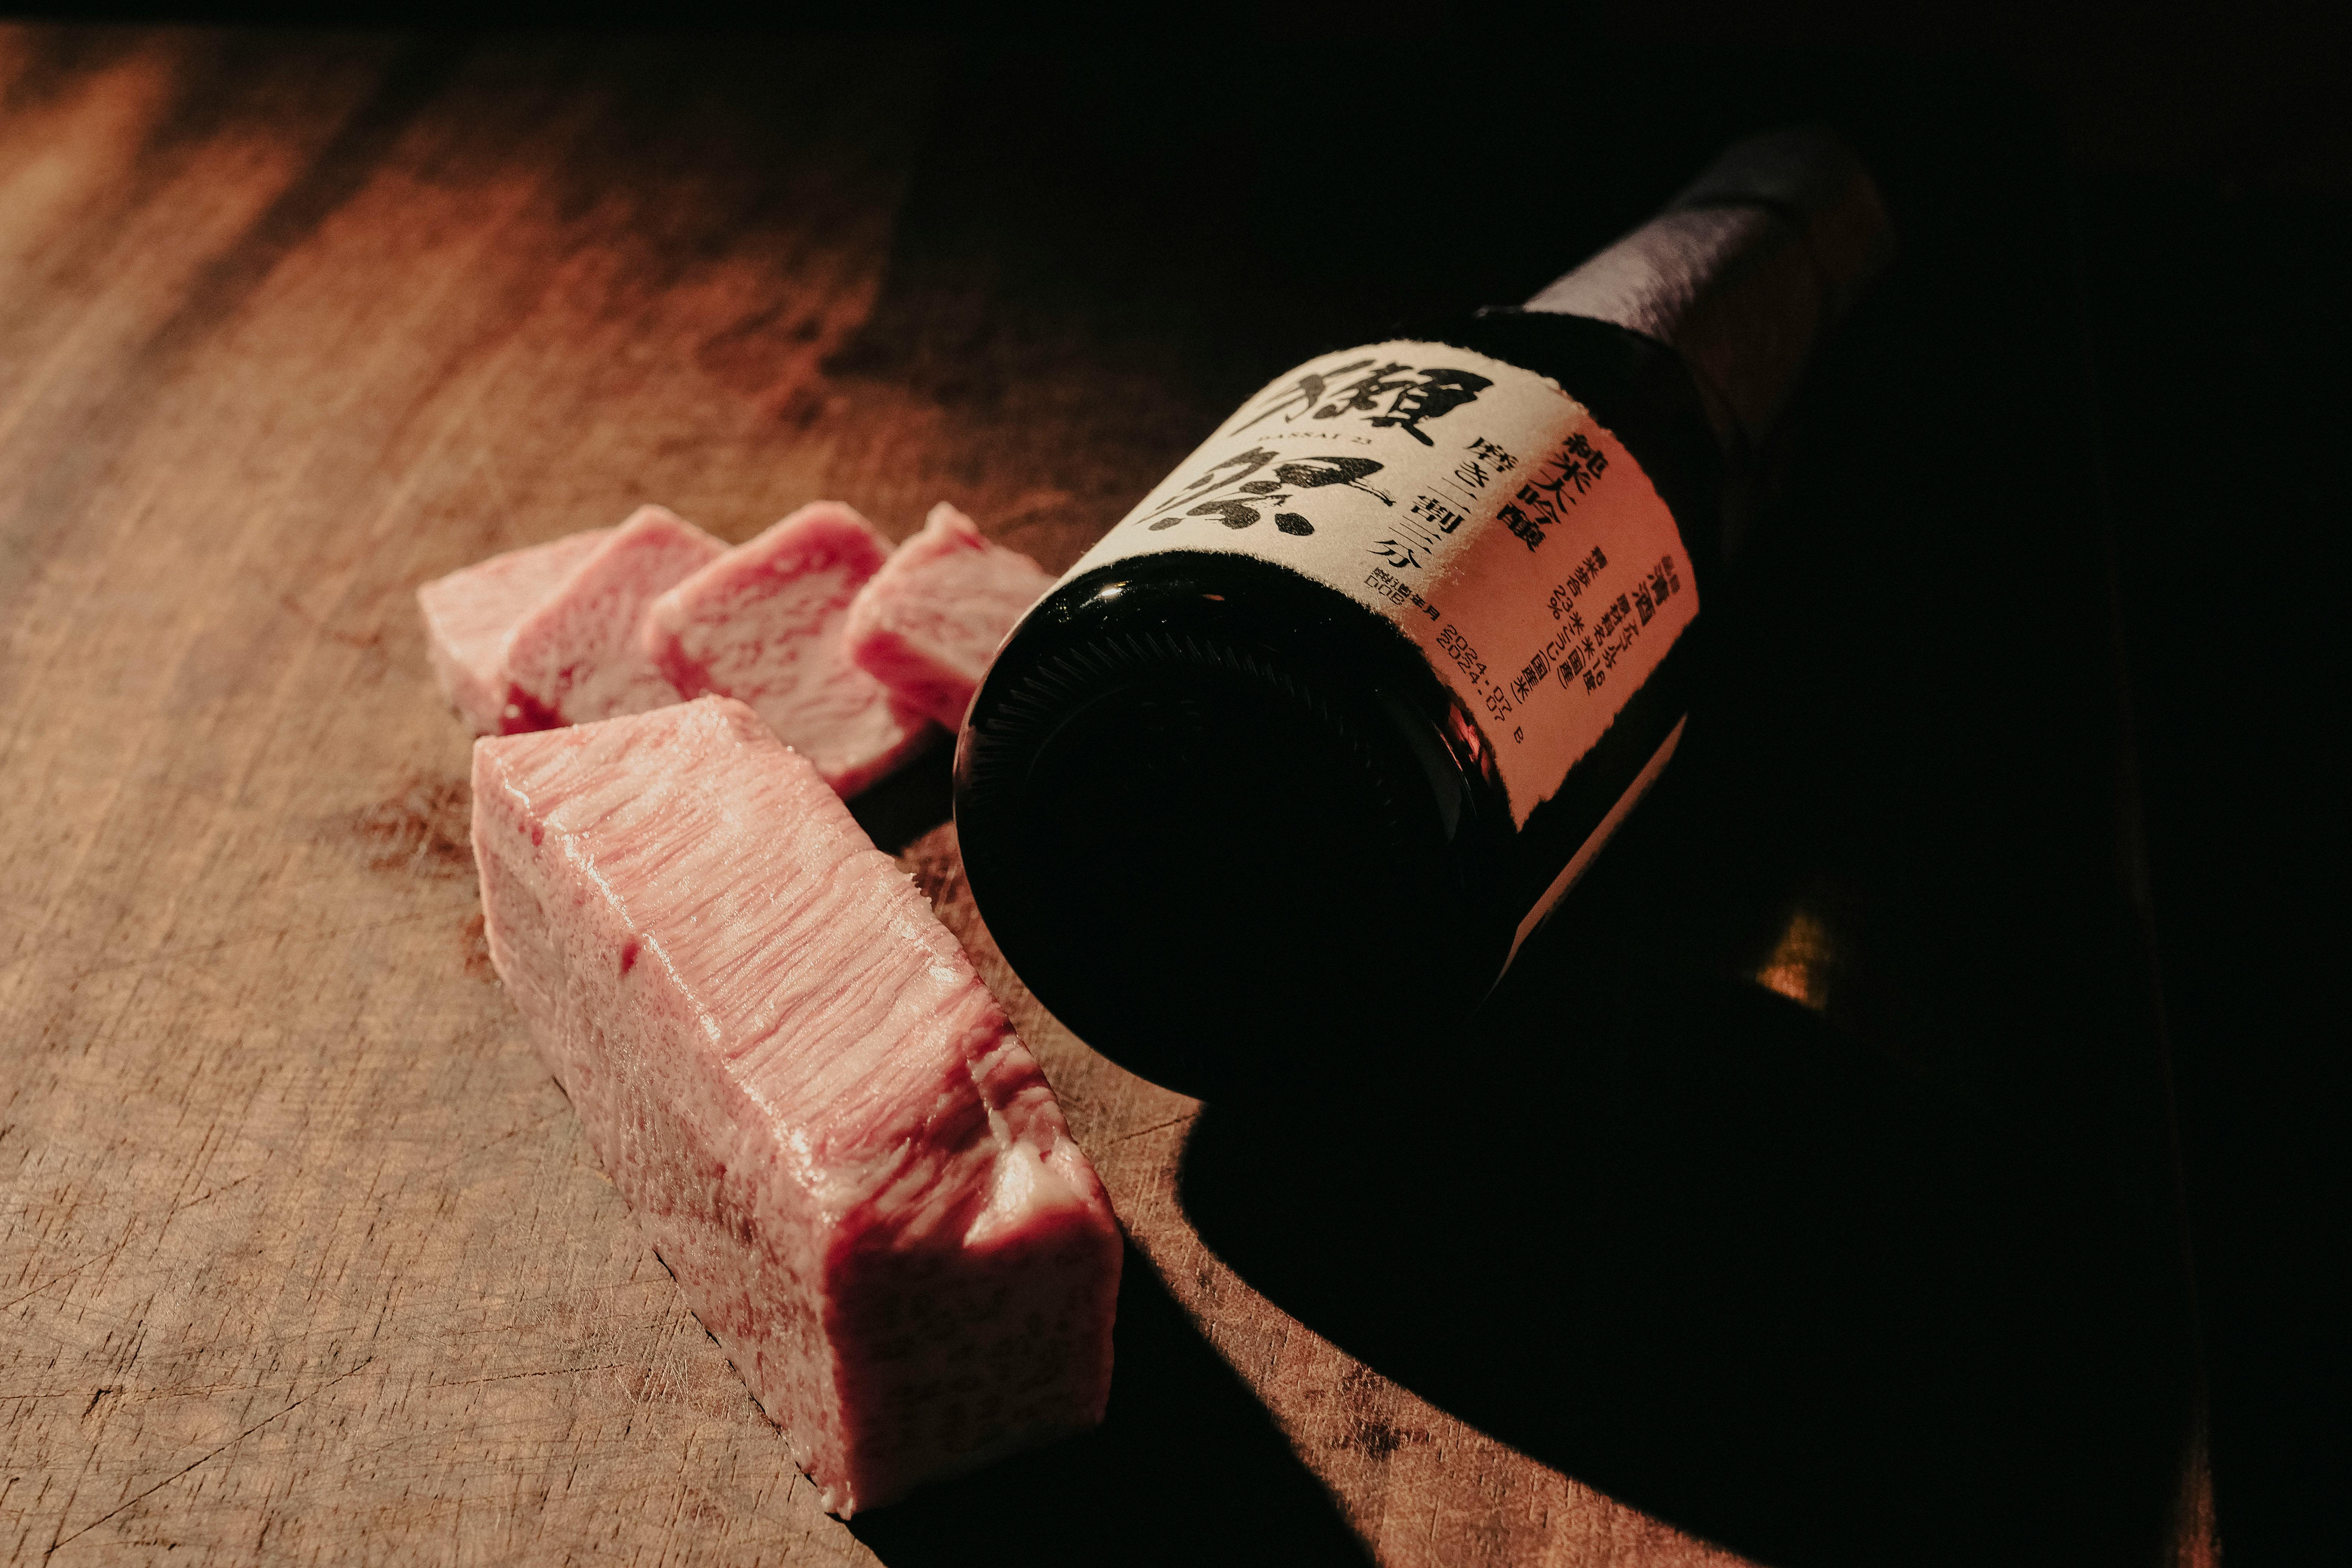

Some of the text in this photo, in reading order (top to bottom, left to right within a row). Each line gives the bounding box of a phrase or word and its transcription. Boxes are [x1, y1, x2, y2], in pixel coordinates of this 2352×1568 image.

[1366, 436, 1519, 569] 磨き二割三分
[1496, 433, 1609, 553] 純米大吟醸
[1364, 575, 1405, 605] DOB
